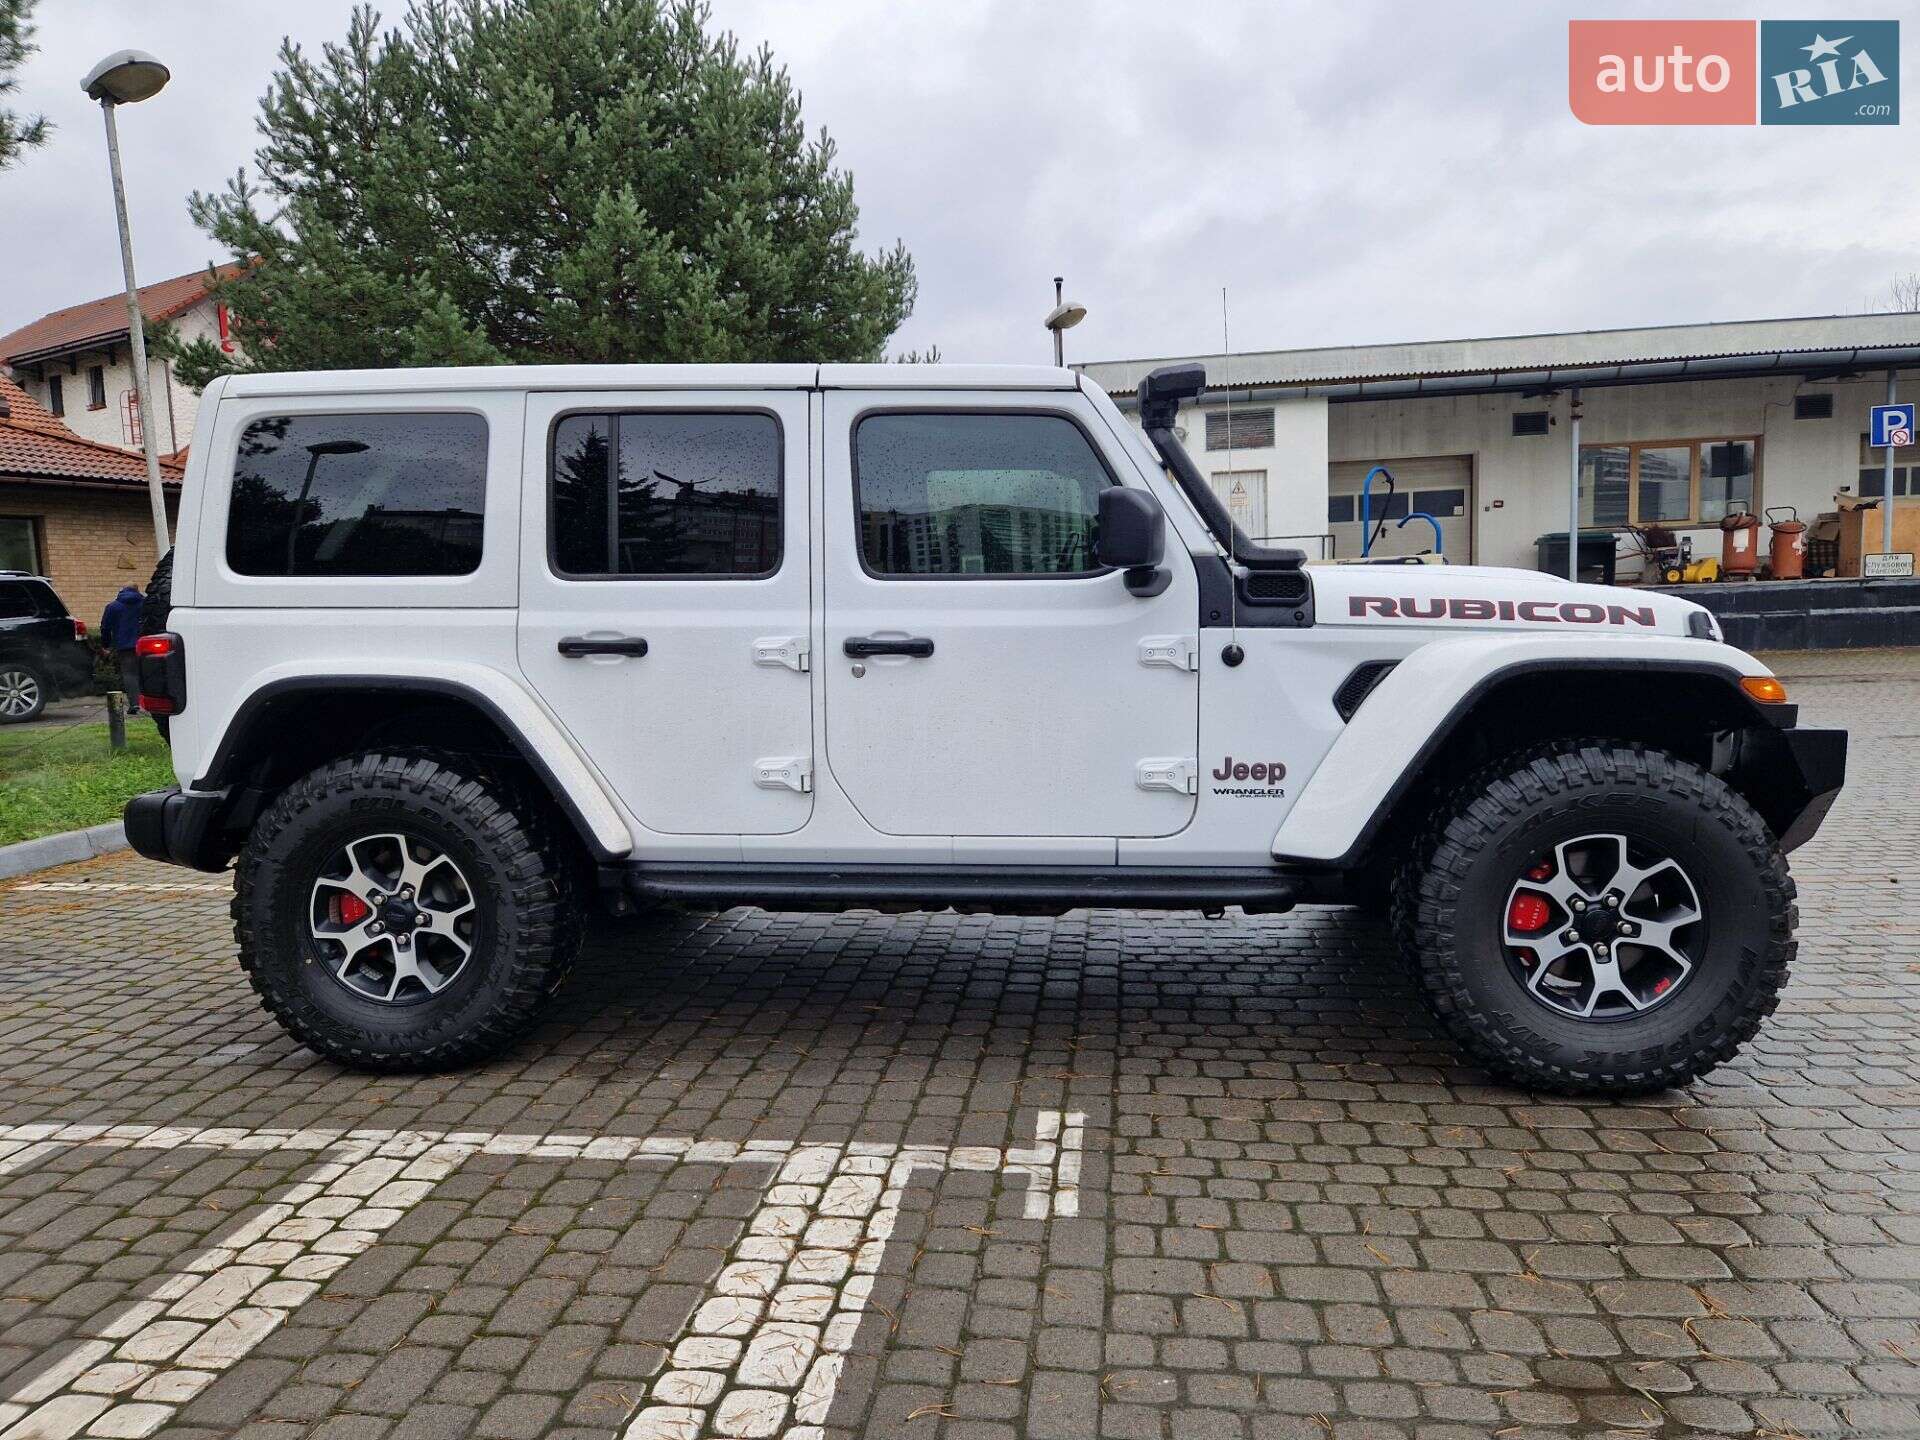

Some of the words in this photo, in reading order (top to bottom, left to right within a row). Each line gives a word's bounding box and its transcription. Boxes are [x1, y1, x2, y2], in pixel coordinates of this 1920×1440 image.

[1882, 410, 1908, 443] P
[1349, 596, 1656, 627] RUBICON
[1213, 757, 1286, 785] Jeep
